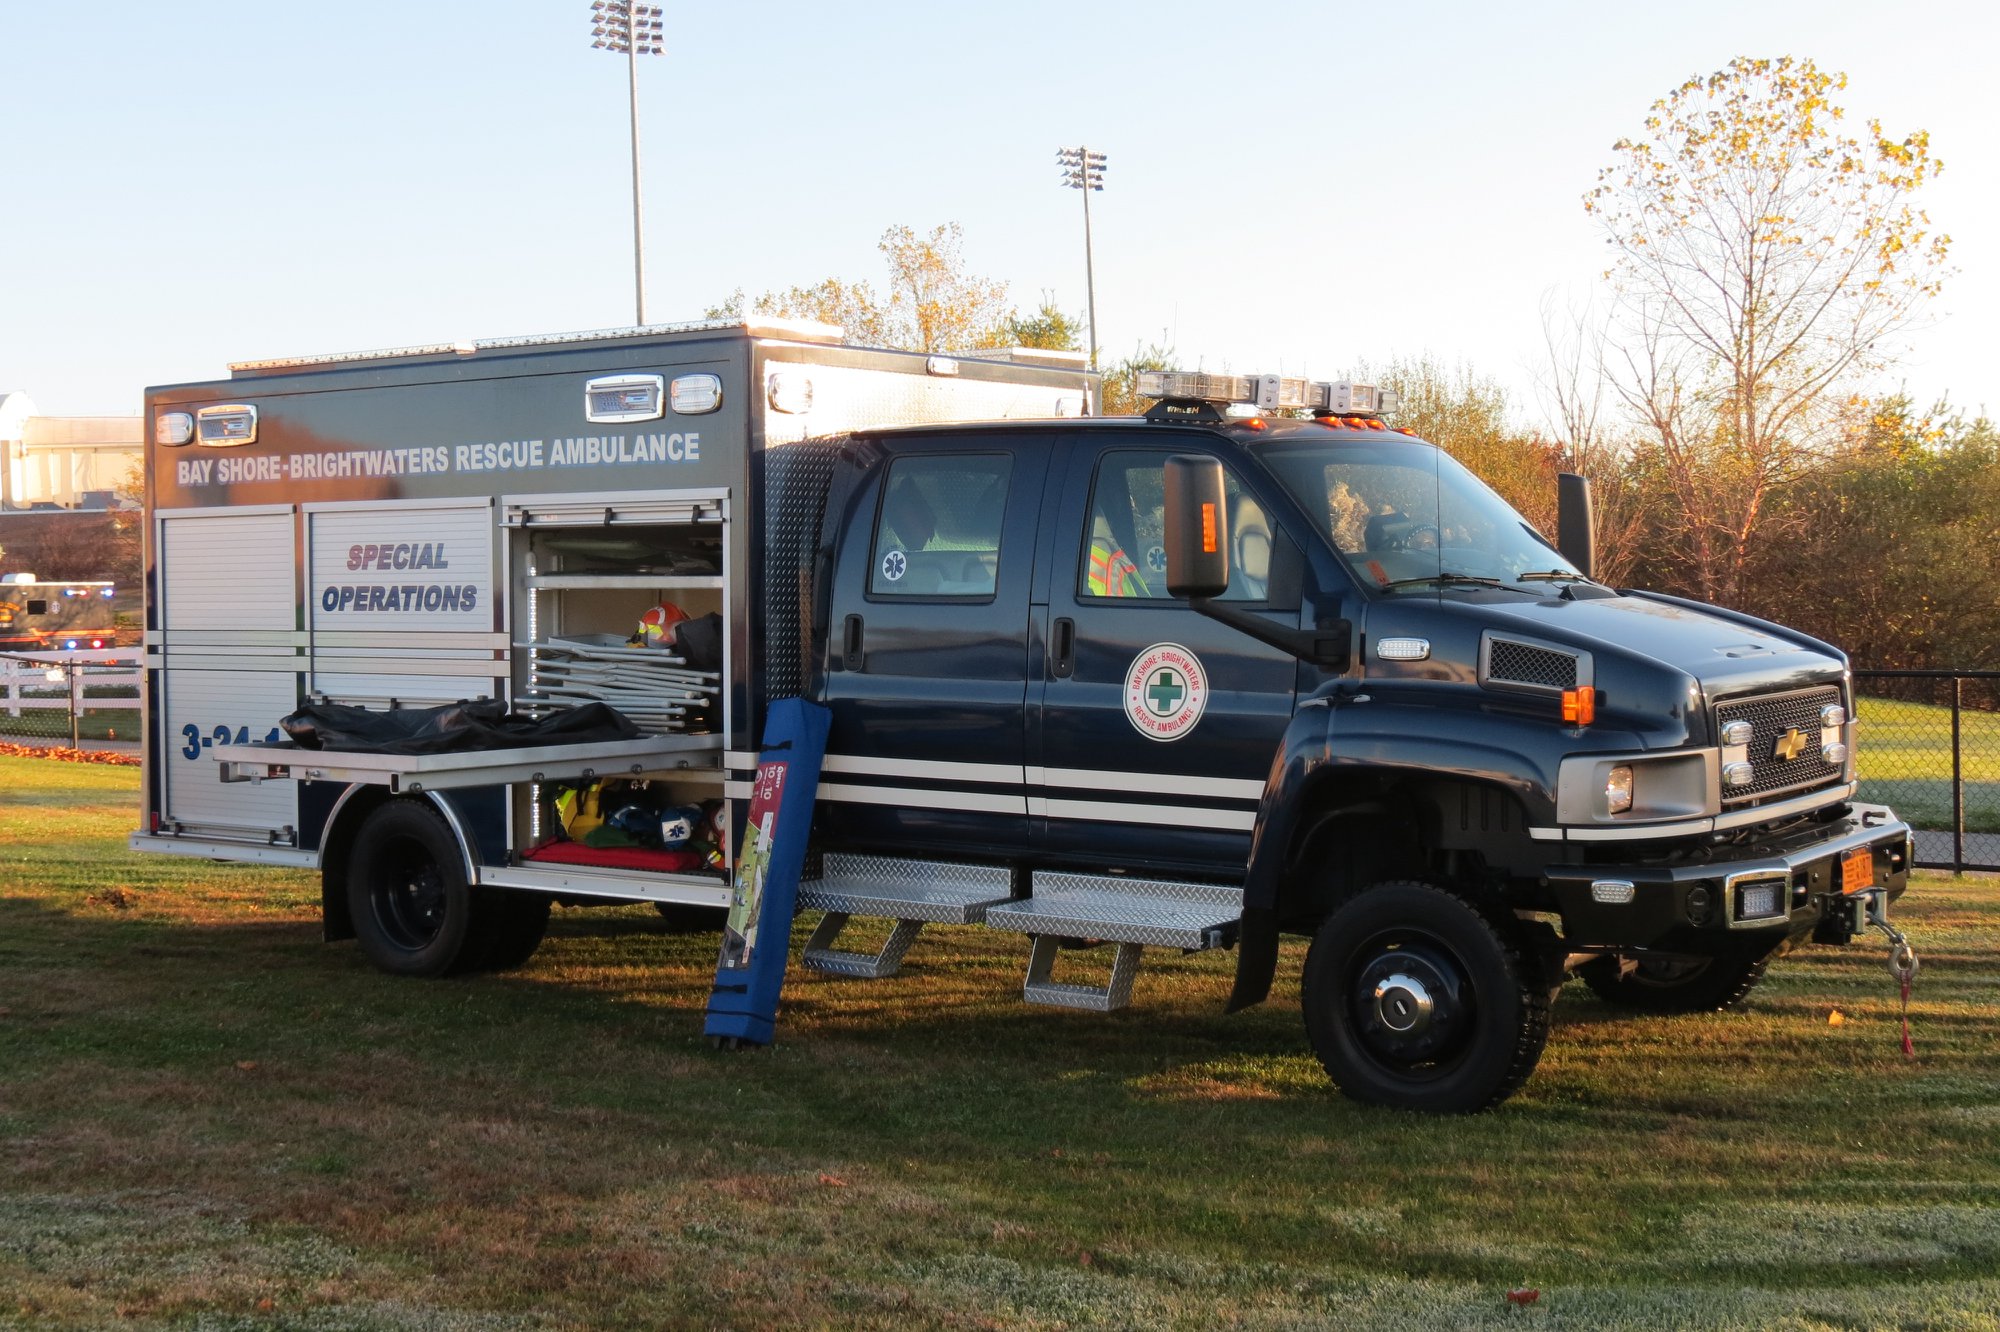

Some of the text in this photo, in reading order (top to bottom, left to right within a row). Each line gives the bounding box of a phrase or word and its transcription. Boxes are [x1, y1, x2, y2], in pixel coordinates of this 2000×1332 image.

[178, 459, 214, 485] BAY
[456, 440, 544, 471] RESCUE
[550, 433, 700, 465] AMBULANCE
[346, 543, 449, 571] SPECIAL
[321, 585, 478, 612] OPERATIONS
[1132, 675, 1142, 690] BAY
[1140, 654, 1157, 675] SHORE
[1161, 652, 1200, 691] BRIGHTWATERS
[1134, 705, 1194, 732] RESCUE AMBULANCE
